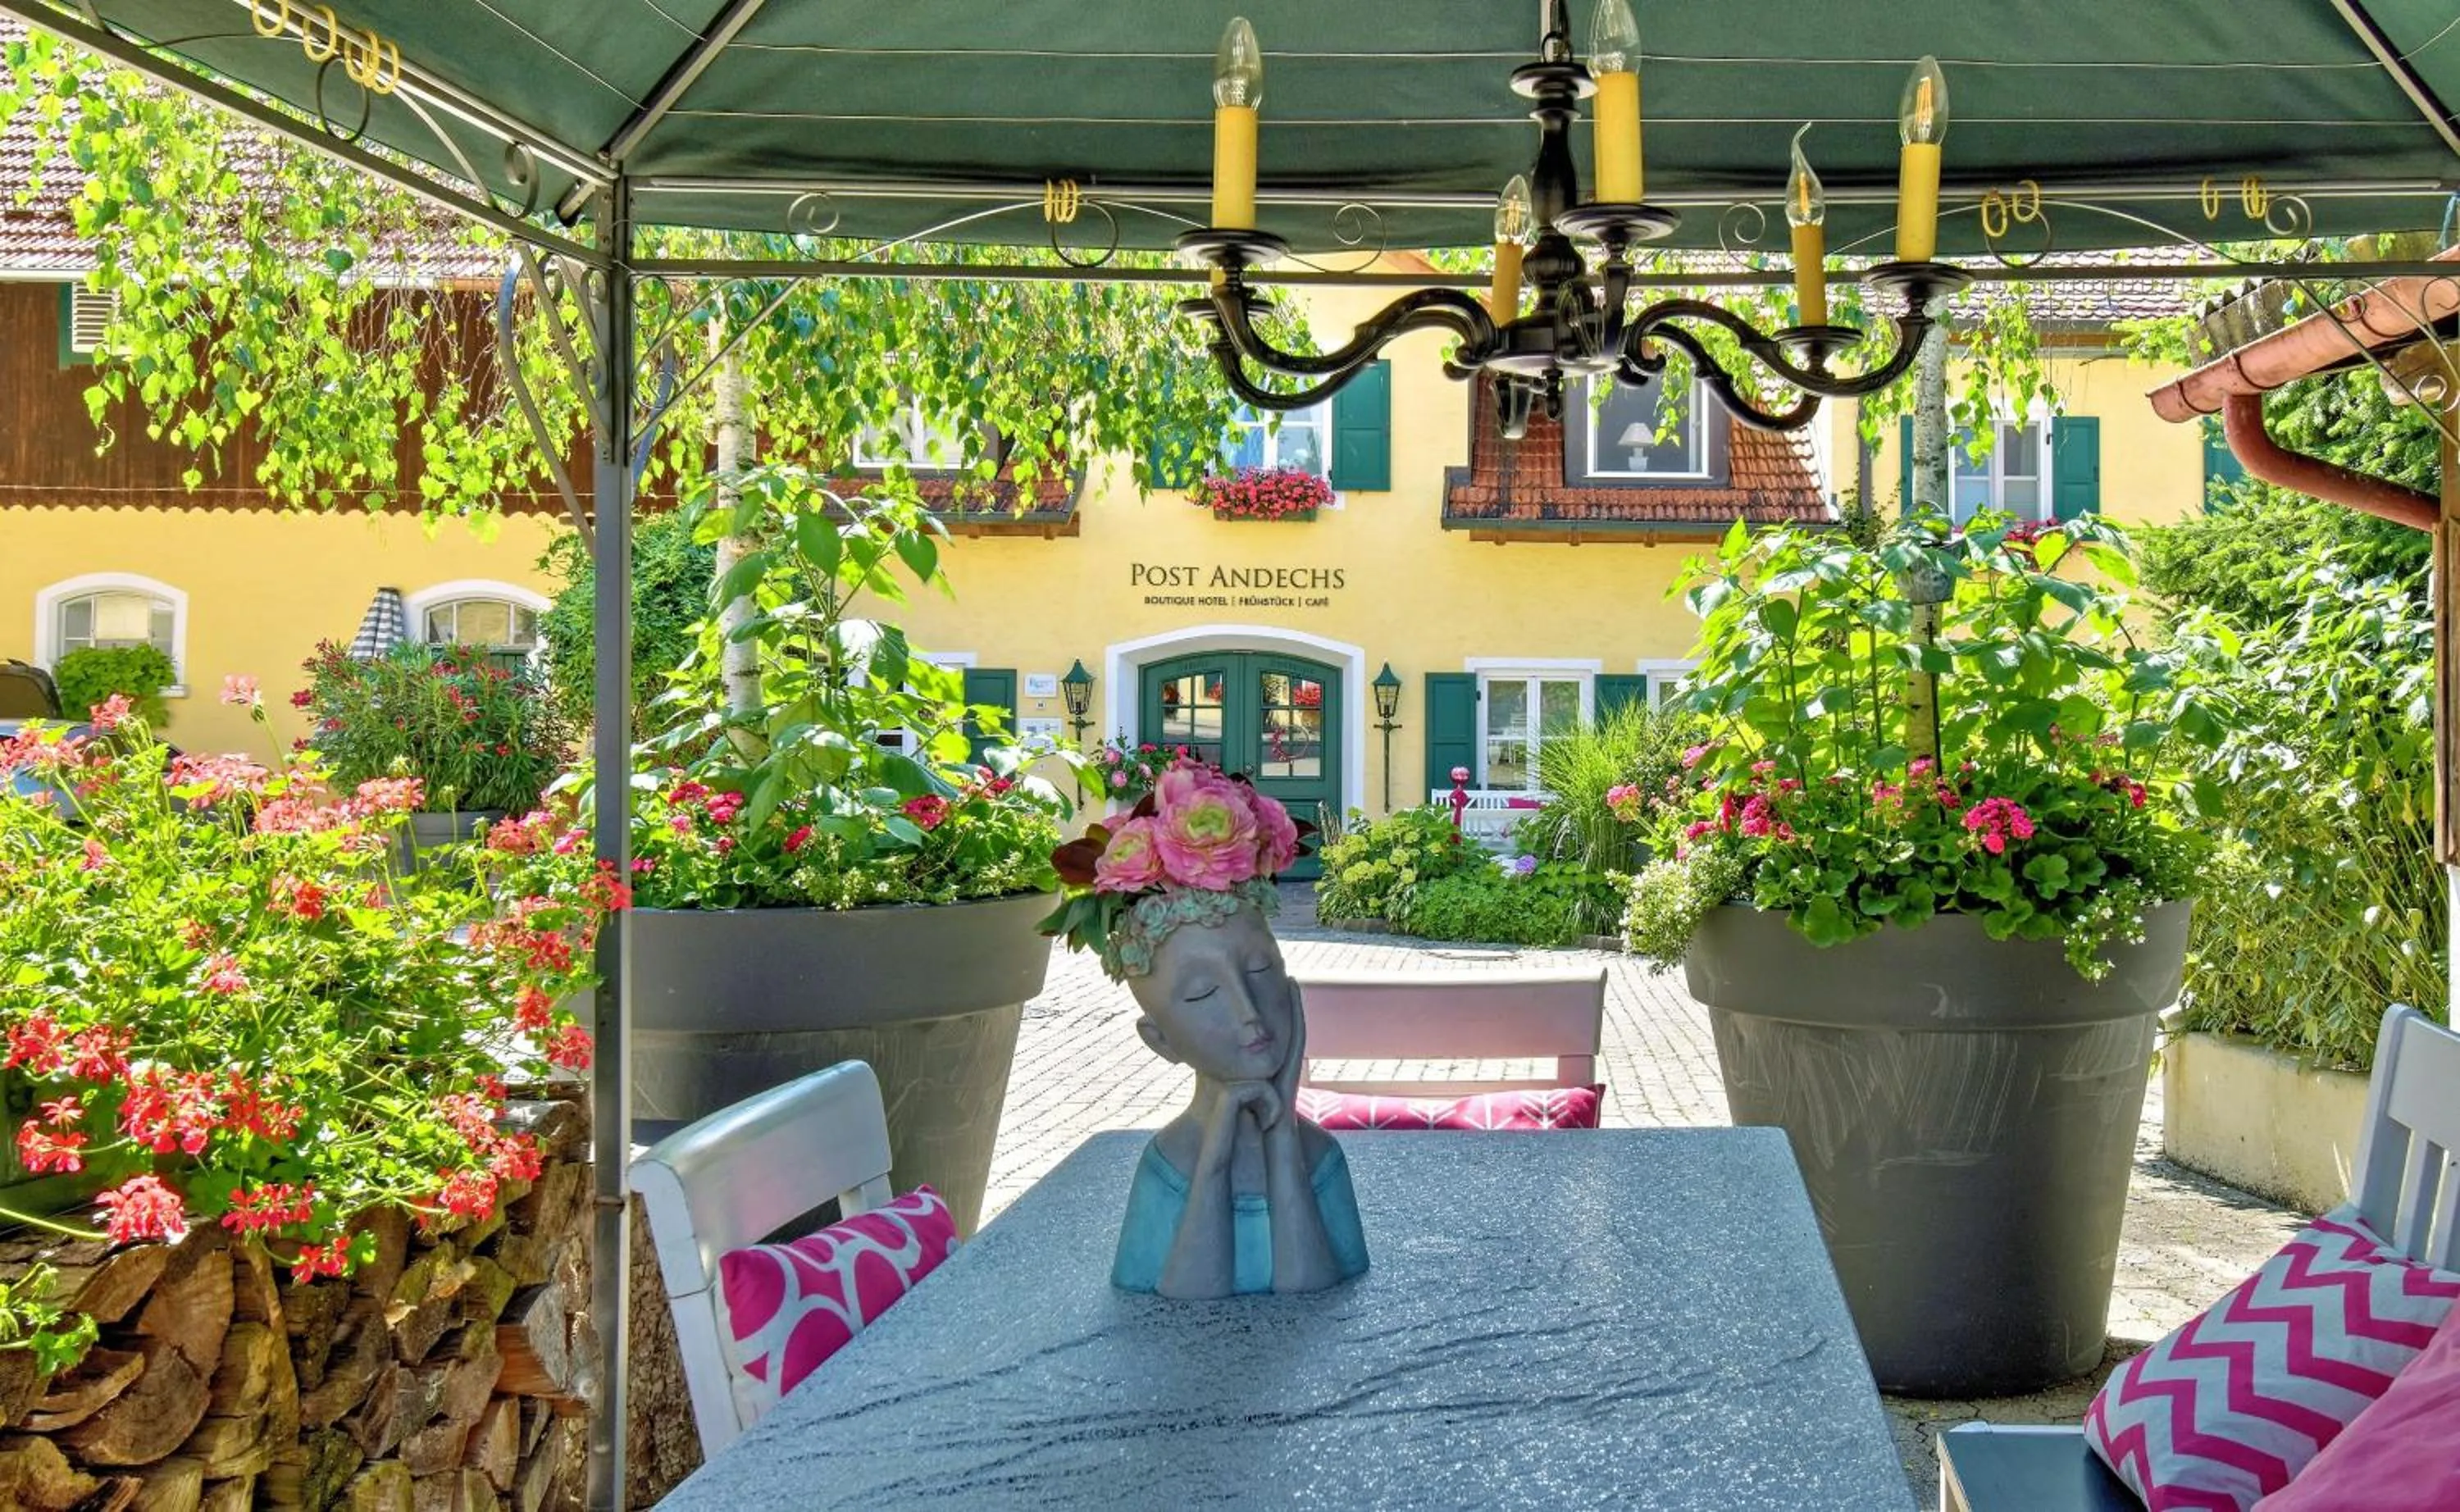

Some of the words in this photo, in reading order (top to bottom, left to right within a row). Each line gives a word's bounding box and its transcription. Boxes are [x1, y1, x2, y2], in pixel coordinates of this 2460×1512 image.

[1131, 563, 1200, 586] POST
[1209, 565, 1346, 590] ANDECHS
[1144, 596, 1195, 606] BOUTIQUE
[1198, 596, 1228, 606] HOTEL
[1238, 594, 1295, 607] FRÜHSTÜCK
